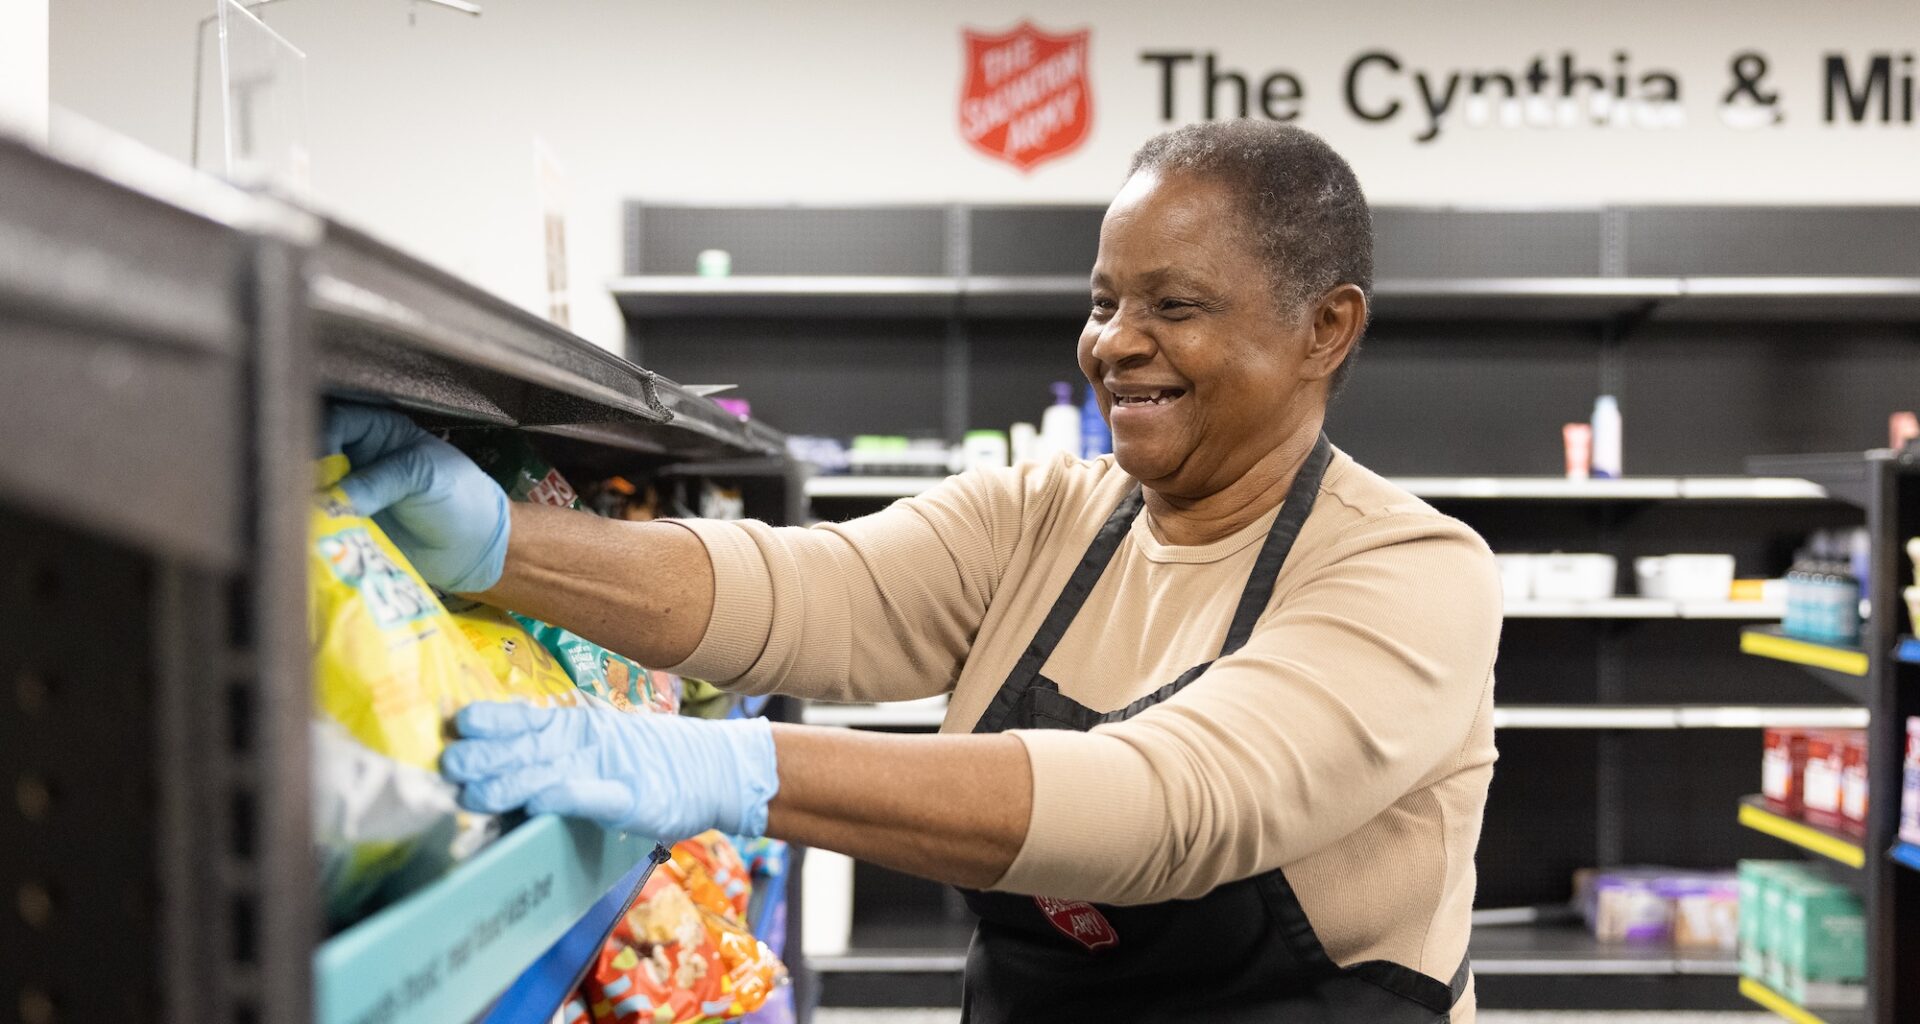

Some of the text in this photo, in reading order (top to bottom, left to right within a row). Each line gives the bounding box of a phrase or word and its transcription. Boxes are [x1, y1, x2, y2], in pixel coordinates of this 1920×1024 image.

[983, 37, 1033, 86] THE
[1004, 86, 1081, 158] ARMY
[1141, 51, 1913, 142] The Cynthia & Mi
[1069, 911, 1102, 936] ARMY
